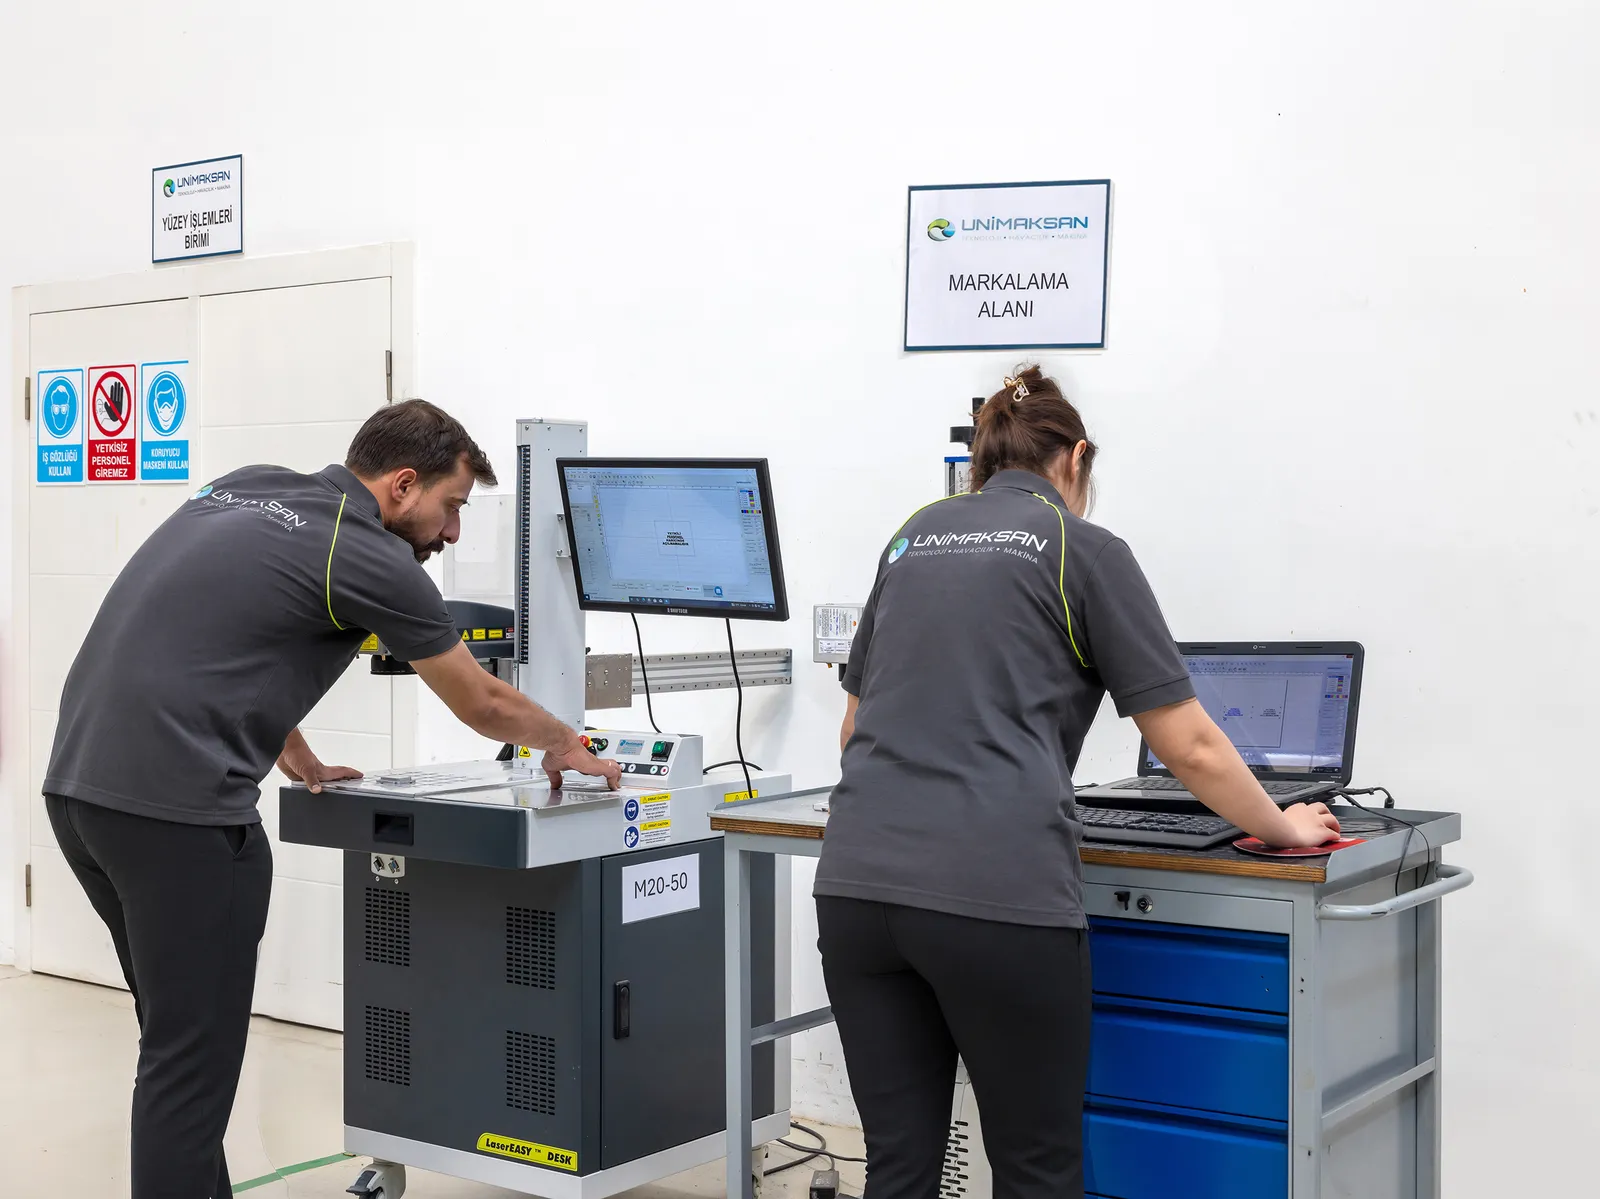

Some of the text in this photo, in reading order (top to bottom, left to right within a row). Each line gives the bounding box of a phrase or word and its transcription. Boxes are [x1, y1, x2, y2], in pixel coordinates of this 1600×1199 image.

[177, 170, 231, 188] UNİMAKSAN
[162, 205, 233, 231] YÜZEY İŞLEMLERİ
[961, 216, 1088, 231] UNİMAKSAN
[184, 229, 210, 249] BİRİMİ
[949, 272, 1069, 291] MARKALAMA
[977, 300, 1034, 318] ALANI
[95, 441, 128, 453] YETKİSİZ
[151, 448, 181, 457] KORUYUCU
[42, 449, 78, 464] İŞ GÖZLÜĞÜ
[92, 455, 131, 465] PERSONEL
[143, 458, 189, 470] MASKENİ KULLAN
[48, 466, 72, 476] KULLAN
[95, 467, 128, 478] GİREMEZ
[913, 530, 1049, 552] UNİMAKSAN
[952, 546, 994, 554] HAVACILIK
[1003, 546, 1038, 564] MAKİNA
[634, 871, 688, 899] M20-50
[485, 1138, 532, 1156] LaserEASY
[547, 1151, 572, 1165] DESK
